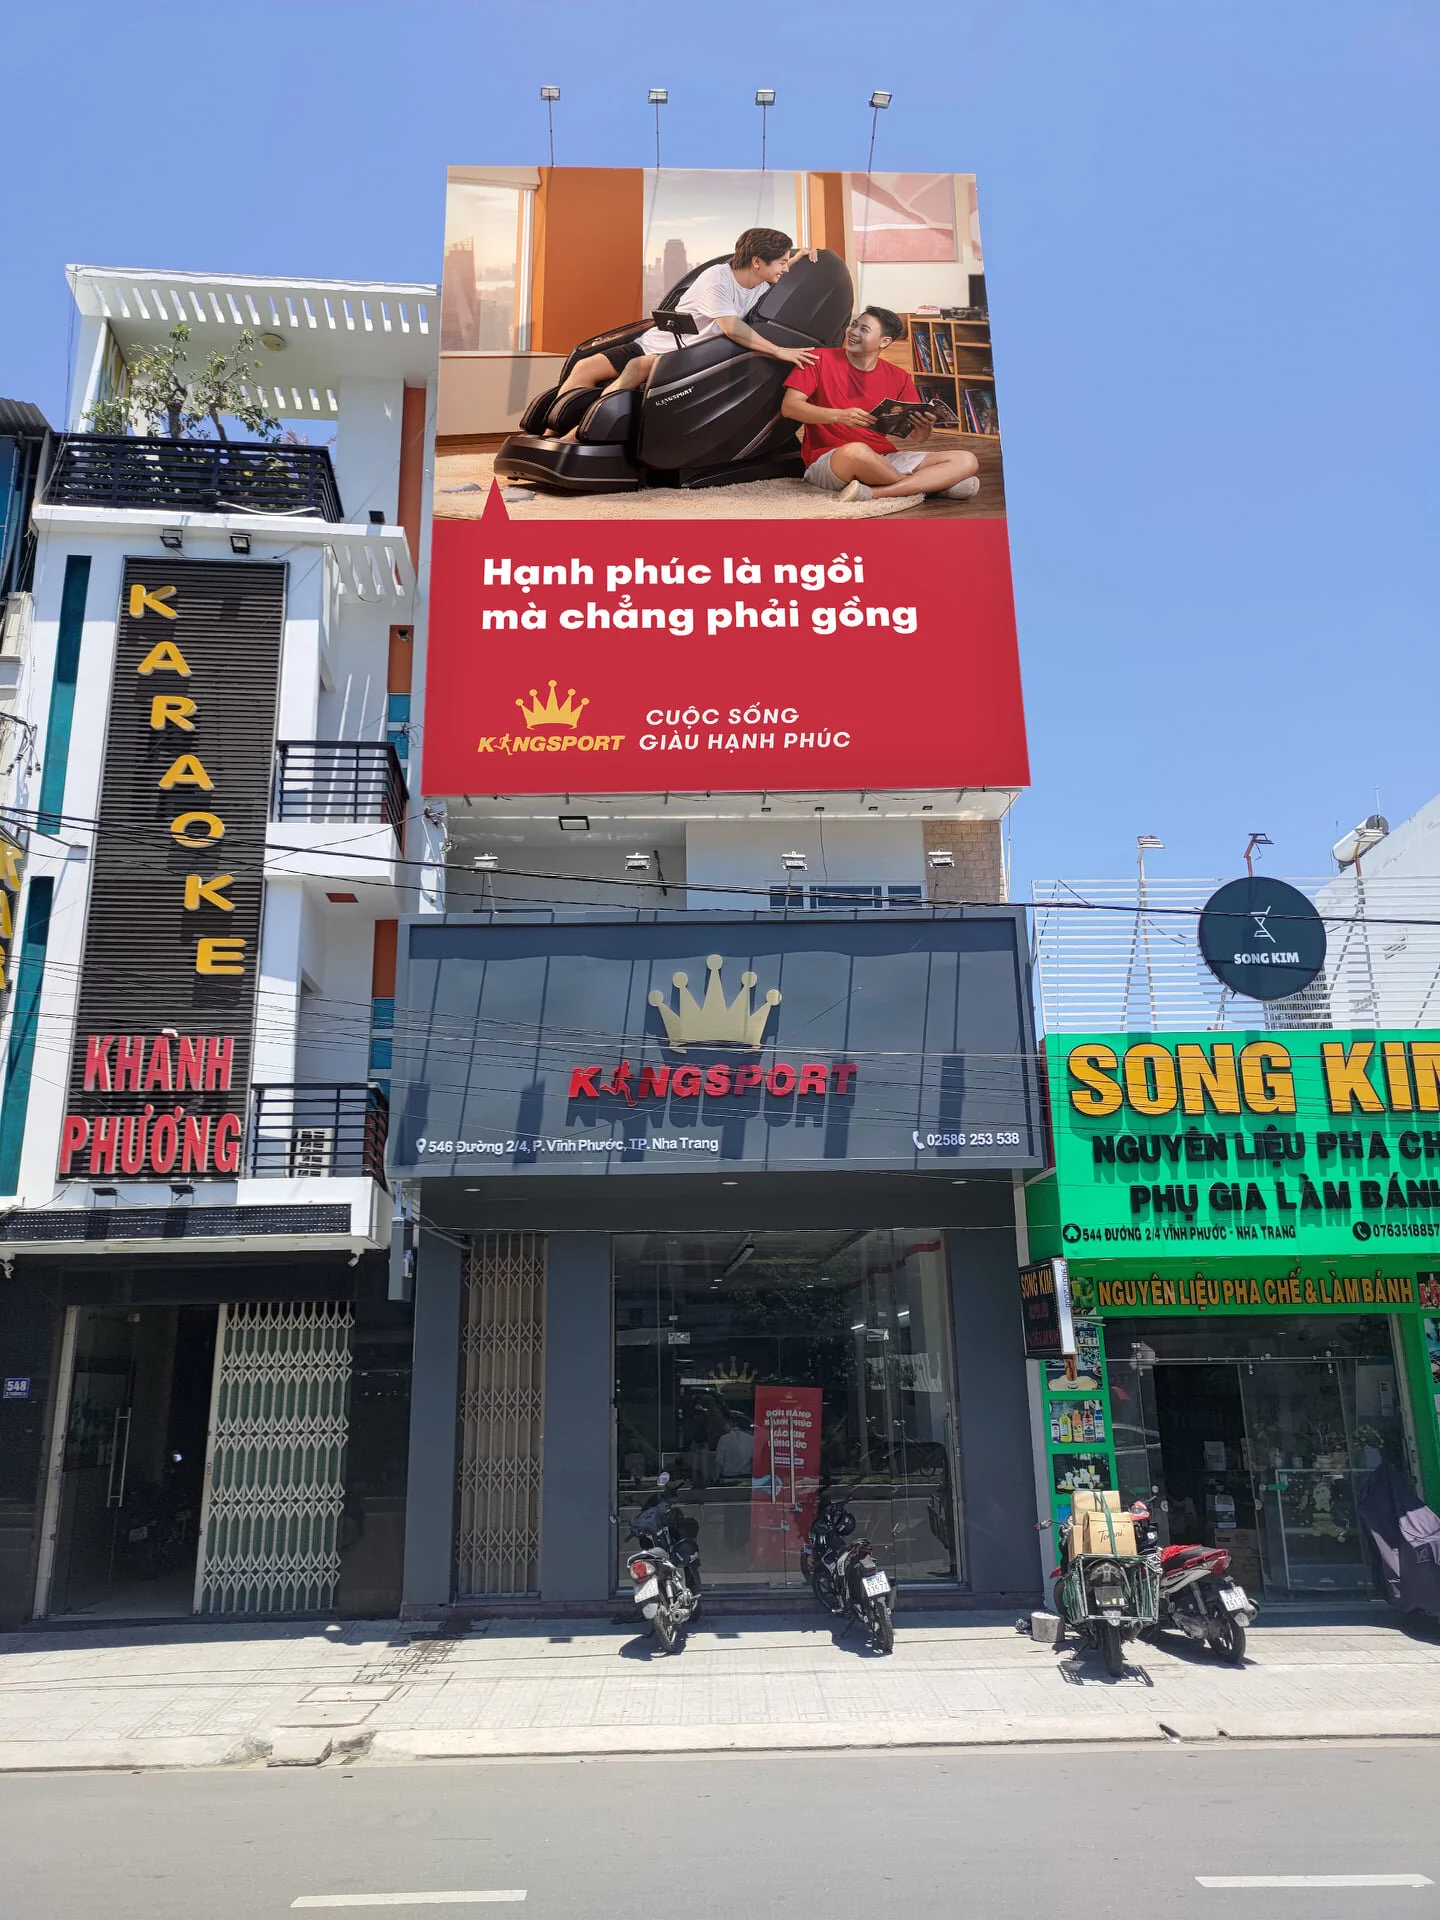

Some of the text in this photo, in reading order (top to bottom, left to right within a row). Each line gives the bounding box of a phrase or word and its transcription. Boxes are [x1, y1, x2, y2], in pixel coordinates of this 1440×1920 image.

[483, 552, 865, 593] Hạnh phúc là ngồi
[482, 594, 918, 636] mà chẳng phải gồng
[646, 701, 800, 730] CUỘC SỐNG
[639, 728, 851, 754] GIÀU HẠNH PHÚC
[128, 583, 248, 976] KARAOKE
[1234, 951, 1300, 965] SONG KIM
[1068, 1042, 1297, 1116] SONG
[59, 1104, 241, 1174] PHƯƠNG
[428, 1137, 719, 1154] 546 Đường 2/4, P. Vĩnh Phước, TP. Nha Trang
[927, 1132, 1019, 1146] 02586 253 538
[1092, 1126, 1228, 1163] NGUYÊN
[1235, 1124, 1306, 1168] LIỆU
[1316, 1131, 1391, 1159] PHA
[1130, 1184, 1199, 1221] PHỤ
[1208, 1182, 1267, 1211] GIA
[1276, 1173, 1352, 1209] LÀM
[1083, 1231, 1100, 1241] 544
[1145, 1229, 1160, 1240] 2/4
[1163, 1224, 1187, 1240] VĨNH
[1190, 1223, 1227, 1240] PHƯỚC
[1236, 1225, 1258, 1239] NHA
[1261, 1225, 1296, 1239] TRANG
[1021, 1269, 1053, 1299] SONG KIM
[1098, 1268, 1414, 1311] NGUYÊN LIỆU PHA CHẾ & LÀM BÁNH
[6, 1380, 27, 1391] 548
